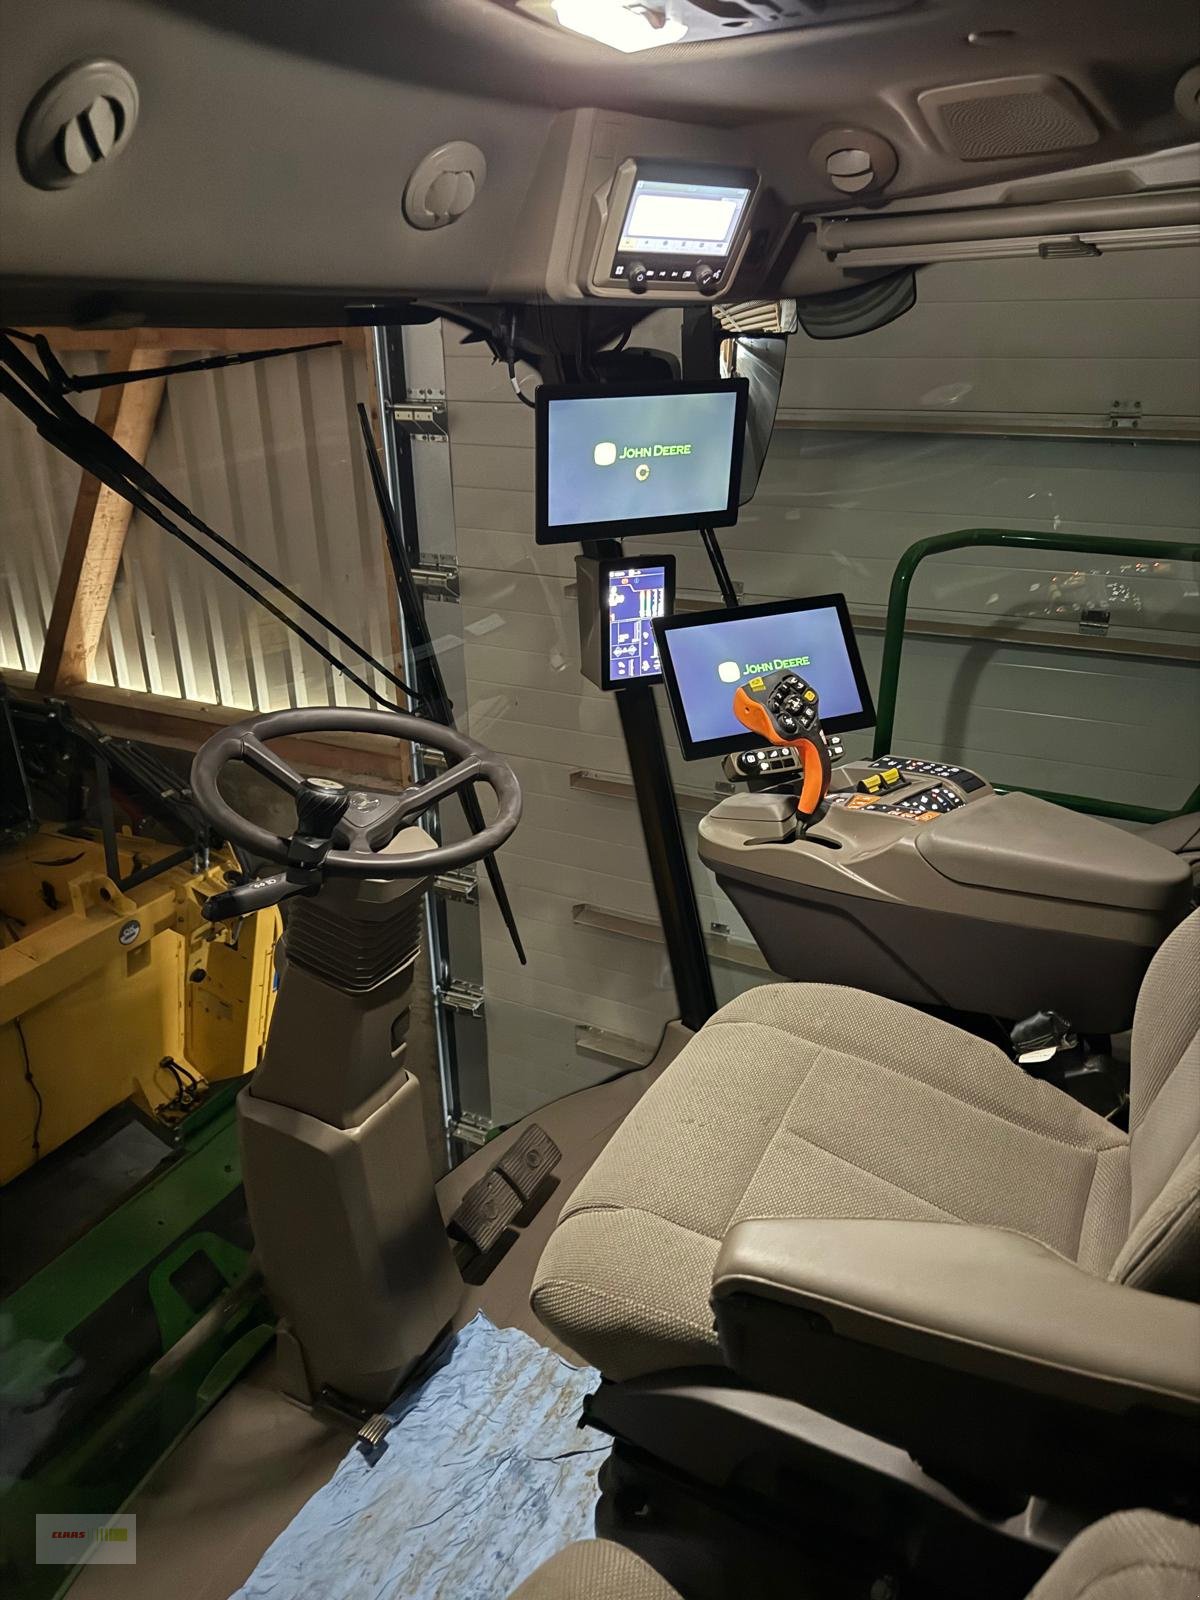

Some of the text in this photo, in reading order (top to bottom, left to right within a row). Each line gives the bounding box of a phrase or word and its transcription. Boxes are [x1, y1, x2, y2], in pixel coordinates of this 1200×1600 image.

[619, 444, 692, 459] JOHN DEERE
[743, 656, 811, 675] JOHN DEERE
